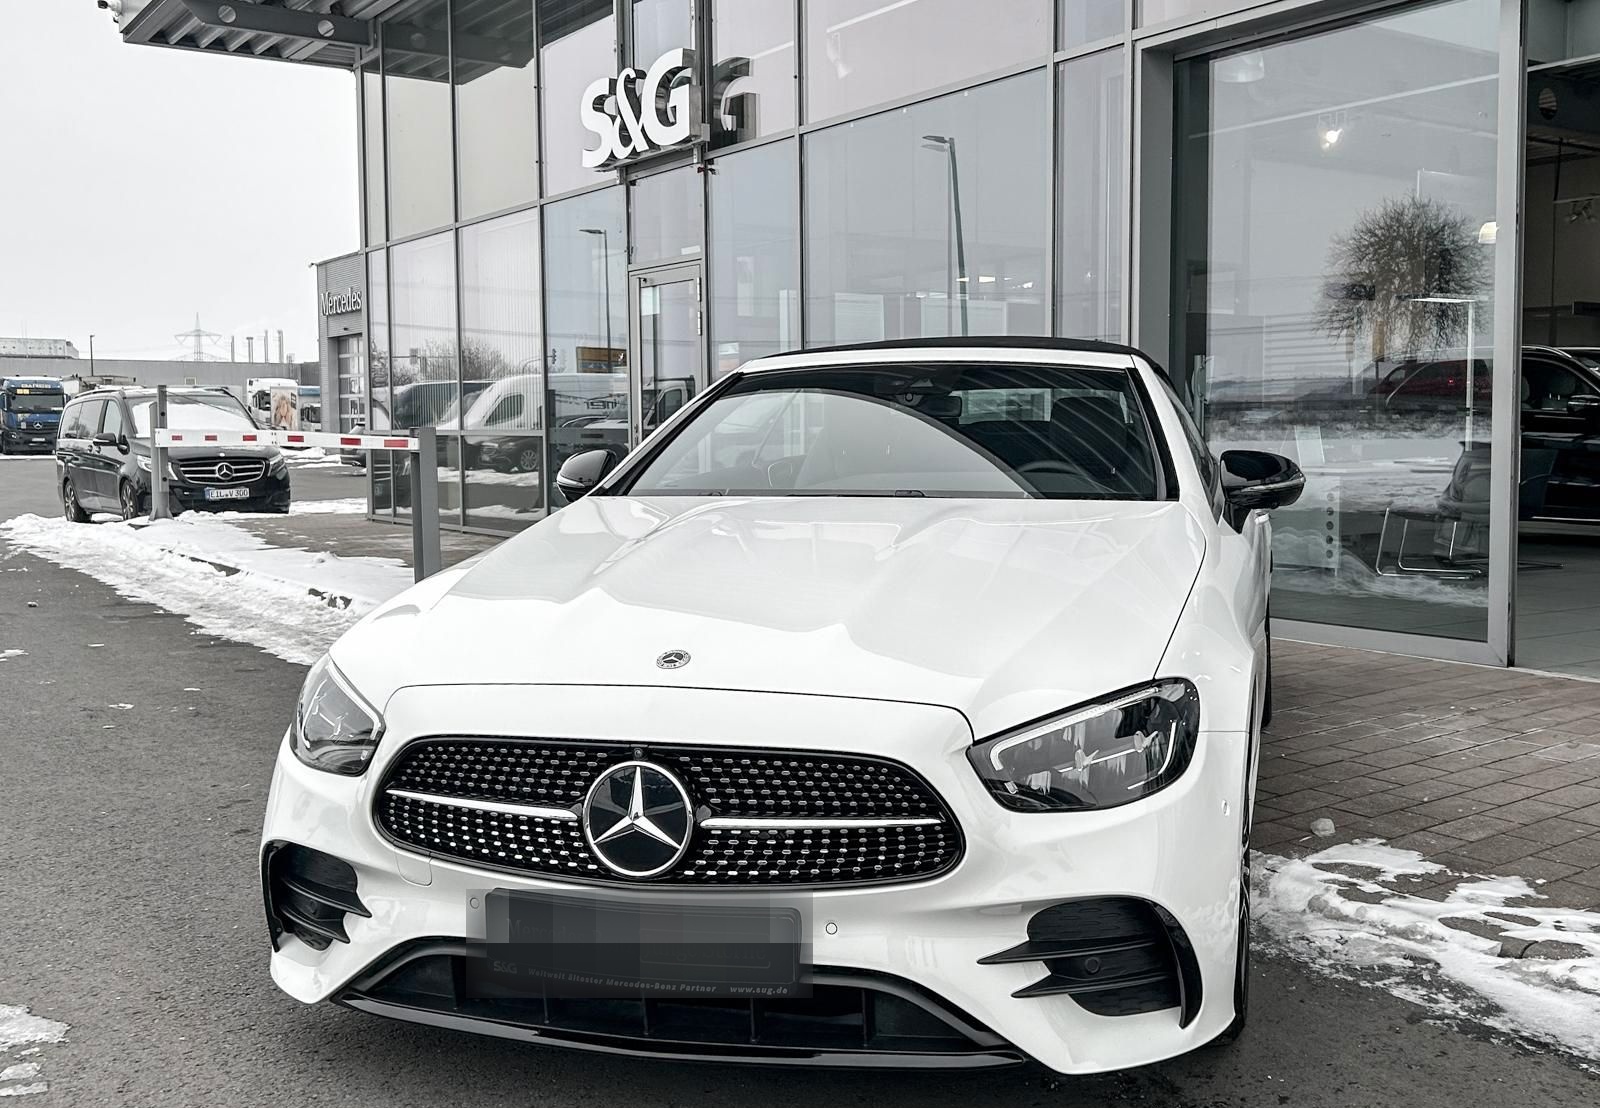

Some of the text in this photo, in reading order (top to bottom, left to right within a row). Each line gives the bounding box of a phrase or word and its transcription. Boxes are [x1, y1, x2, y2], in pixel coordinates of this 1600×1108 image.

[580, 47, 697, 168] S&G
[493, 960, 518, 975] S&G
[605, 978, 677, 991] Mercedes-Benz
[680, 983, 718, 993] Partner
